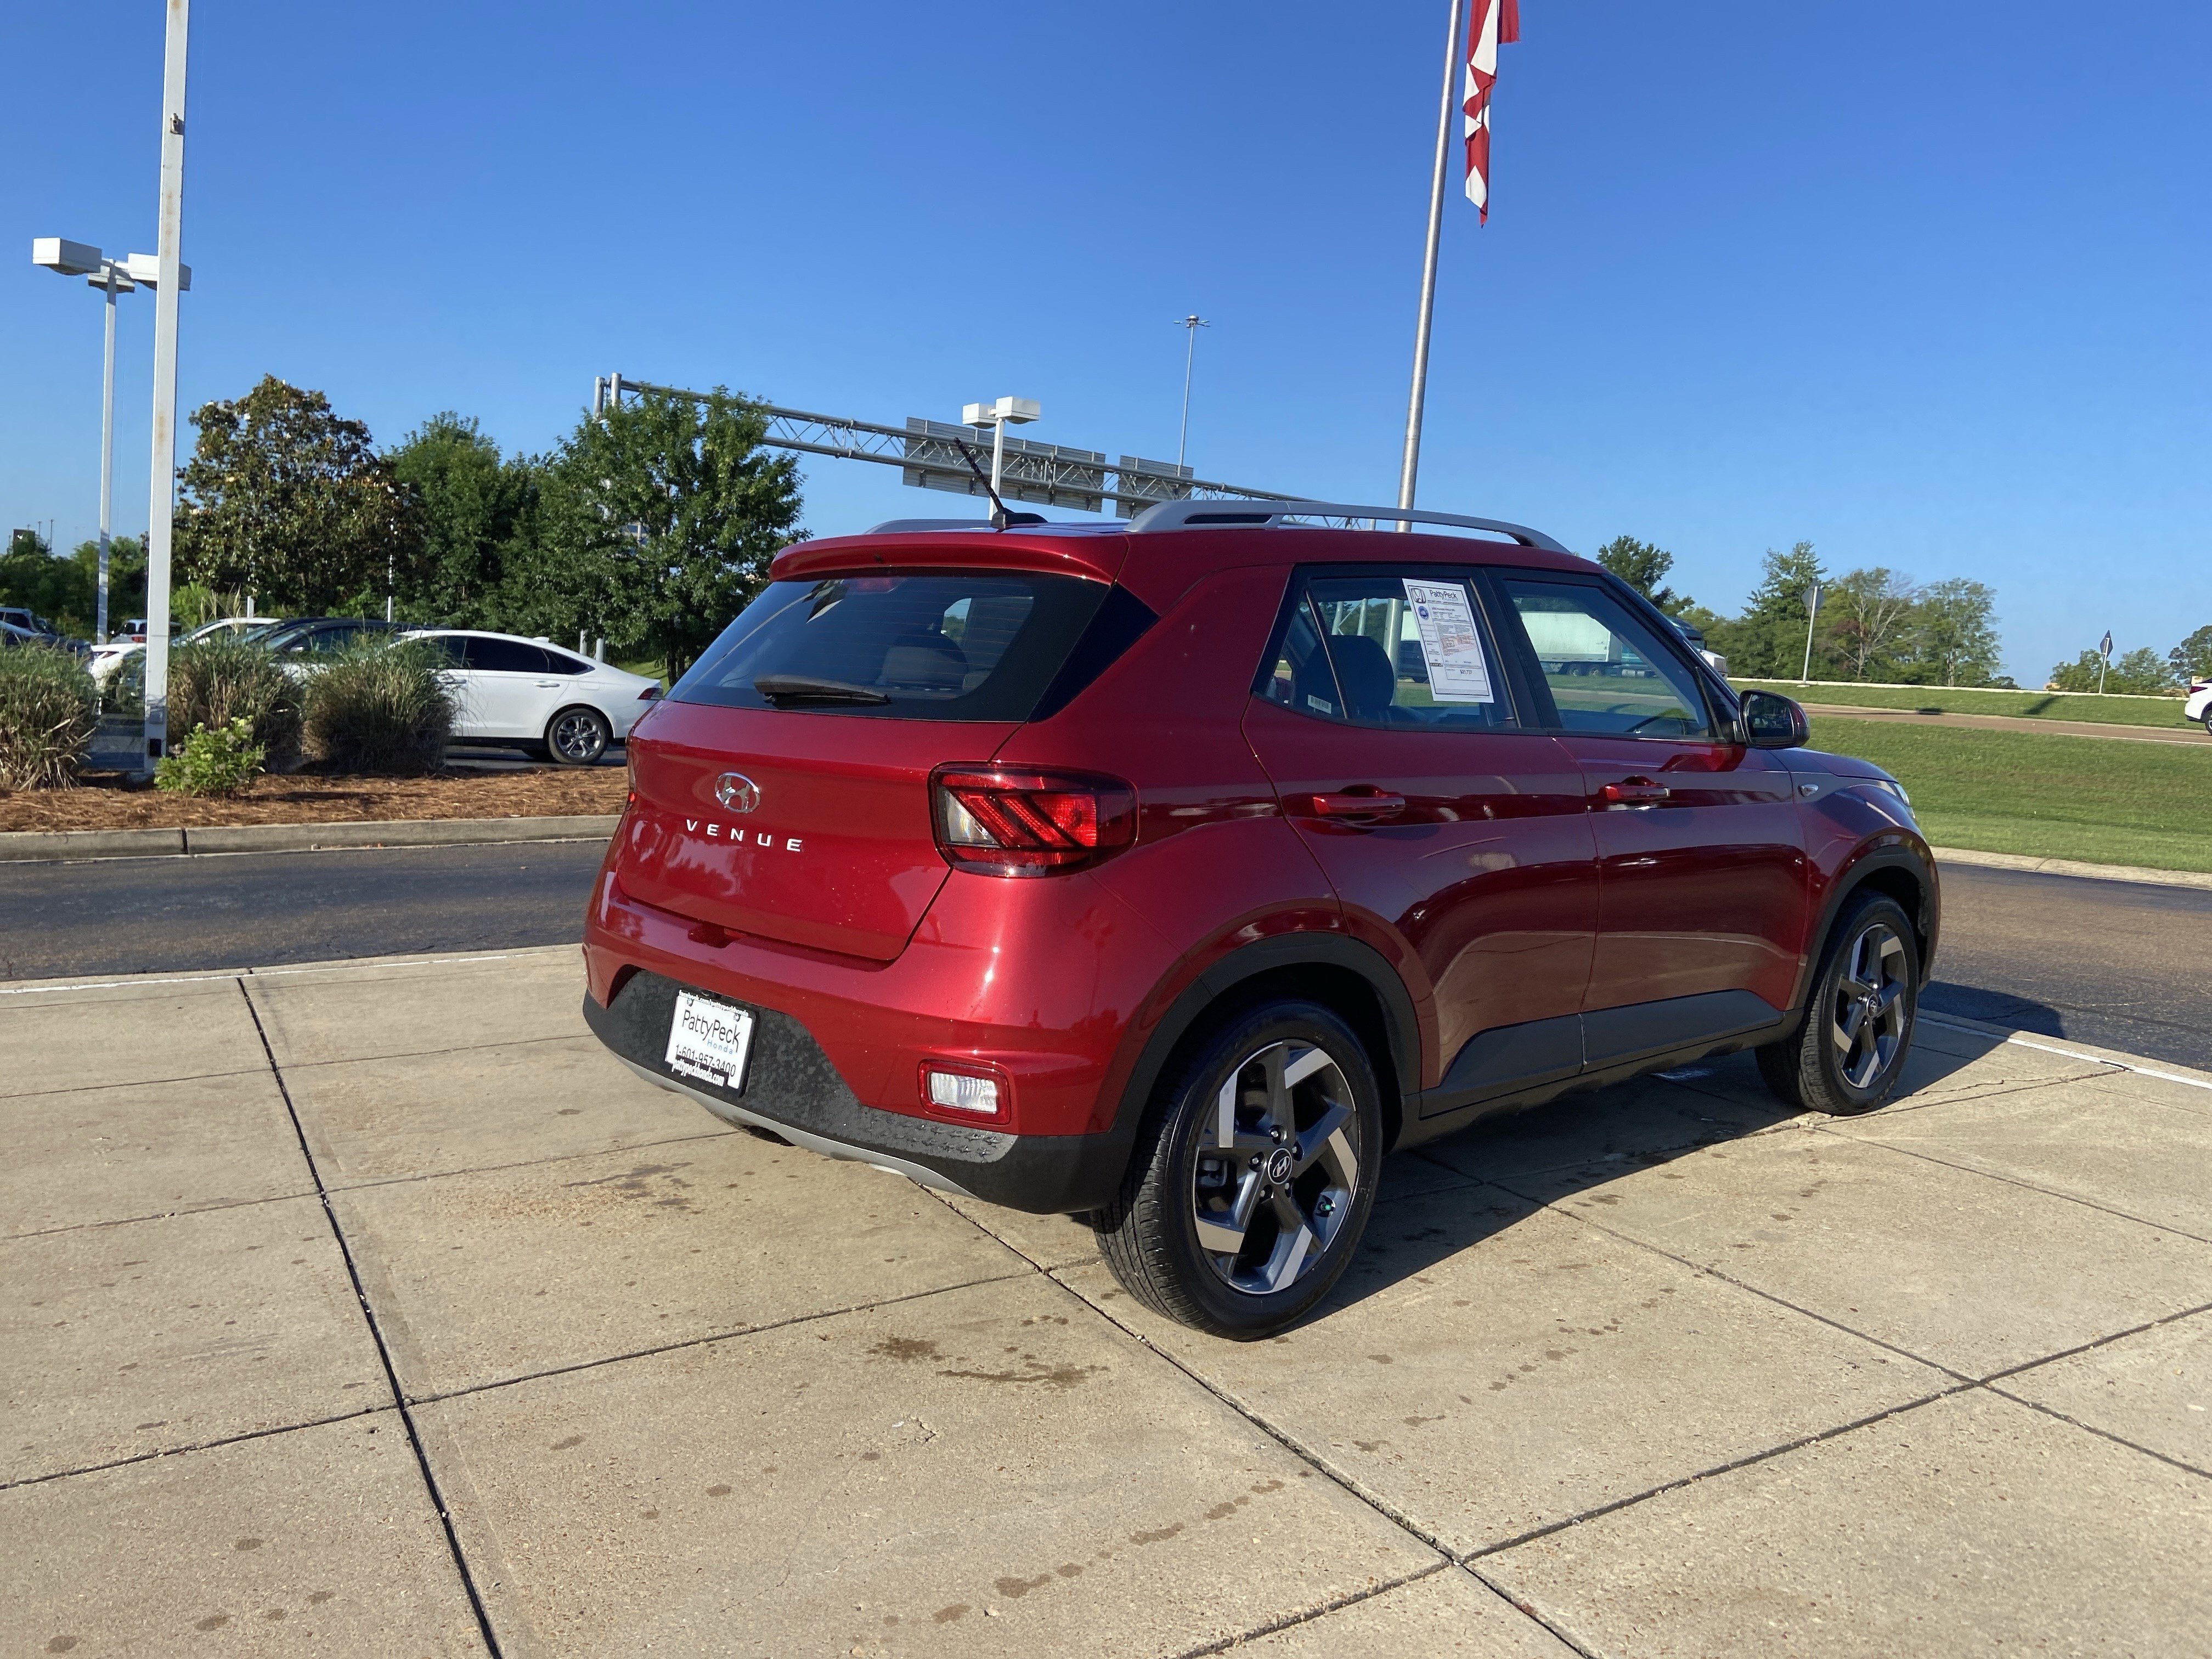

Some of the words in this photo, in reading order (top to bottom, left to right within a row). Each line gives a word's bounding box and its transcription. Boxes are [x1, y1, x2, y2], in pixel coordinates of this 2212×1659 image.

[686, 819, 803, 851] VENUE
[682, 1009, 741, 1052] PattyPeck
[676, 1044, 736, 1077] 1-601-957-3400
[707, 1040, 733, 1054] Honda
[671, 1058, 725, 1086] pattypeckhonda.com
